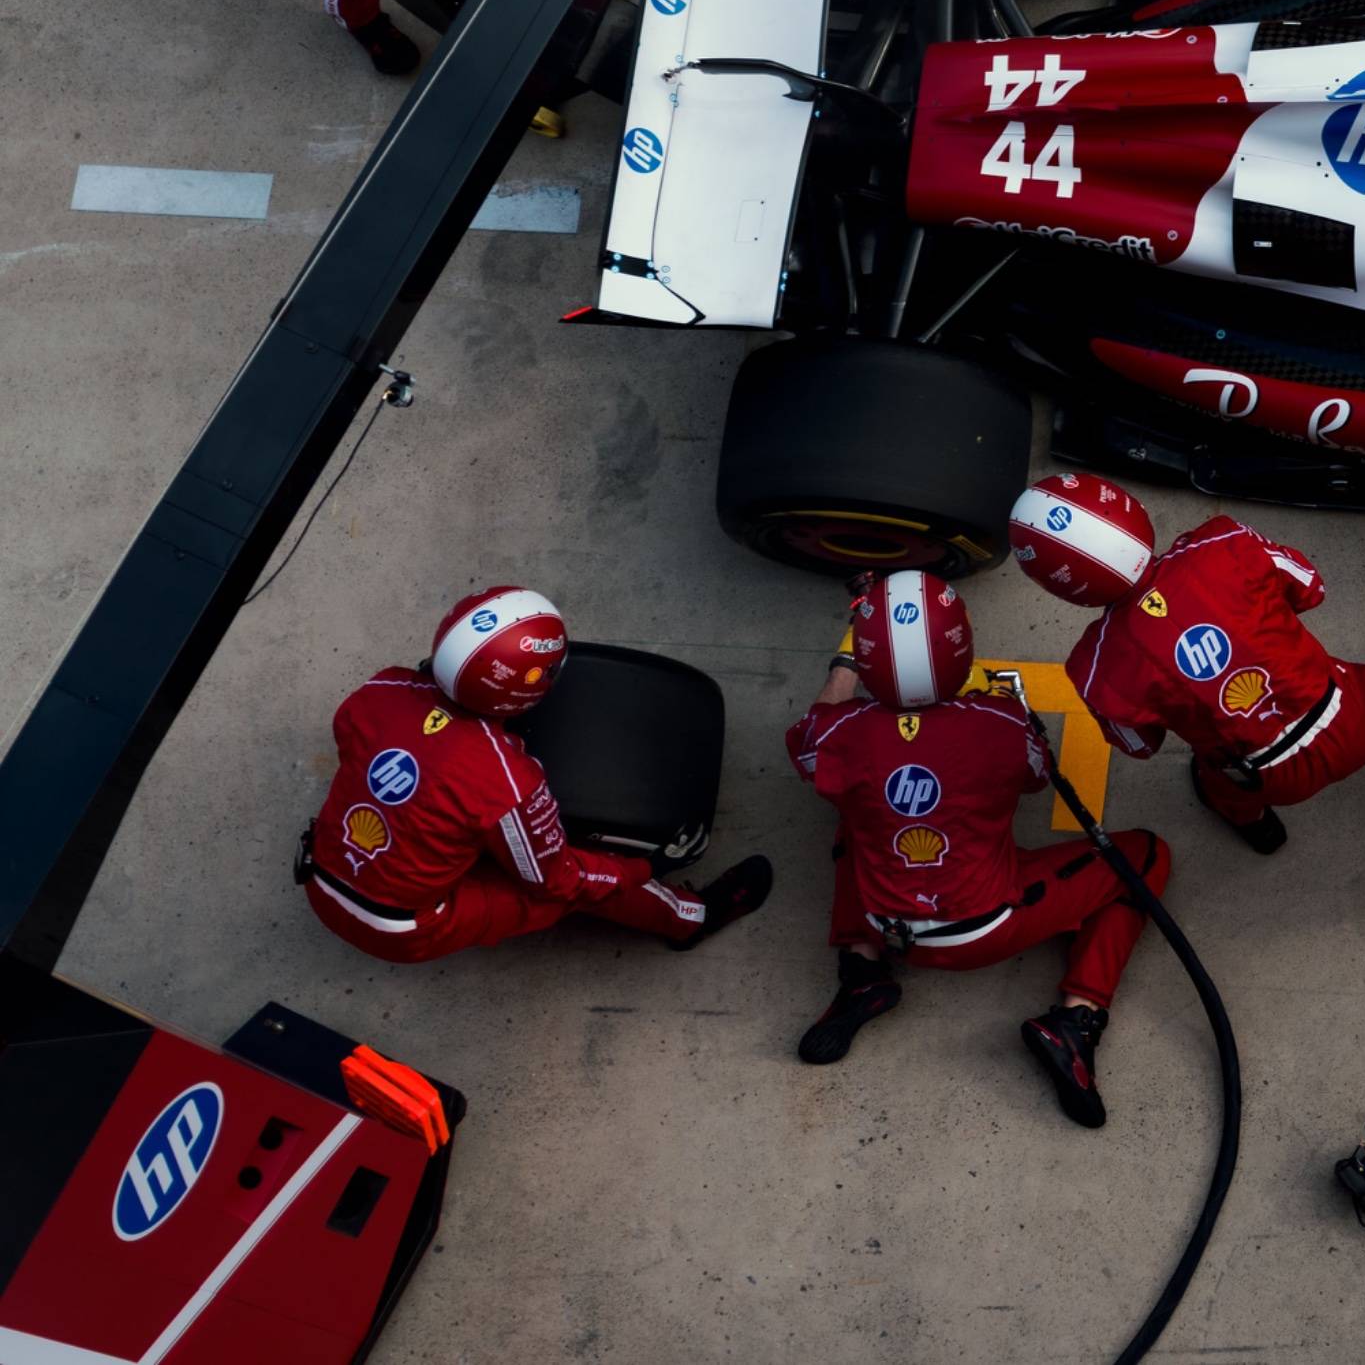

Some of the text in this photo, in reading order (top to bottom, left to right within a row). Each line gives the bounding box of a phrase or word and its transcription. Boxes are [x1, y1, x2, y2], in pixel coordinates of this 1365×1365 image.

[984, 54, 1086, 112] 44
[623, 127, 662, 173] hp
[980, 121, 1082, 199] 44
[1046, 505, 1073, 532] hp
[471, 610, 497, 632] hp
[894, 602, 919, 624] hp
[1177, 624, 1231, 680] hp
[368, 749, 419, 804] hp
[886, 765, 940, 816] hp
[113, 1083, 224, 1242] hp
